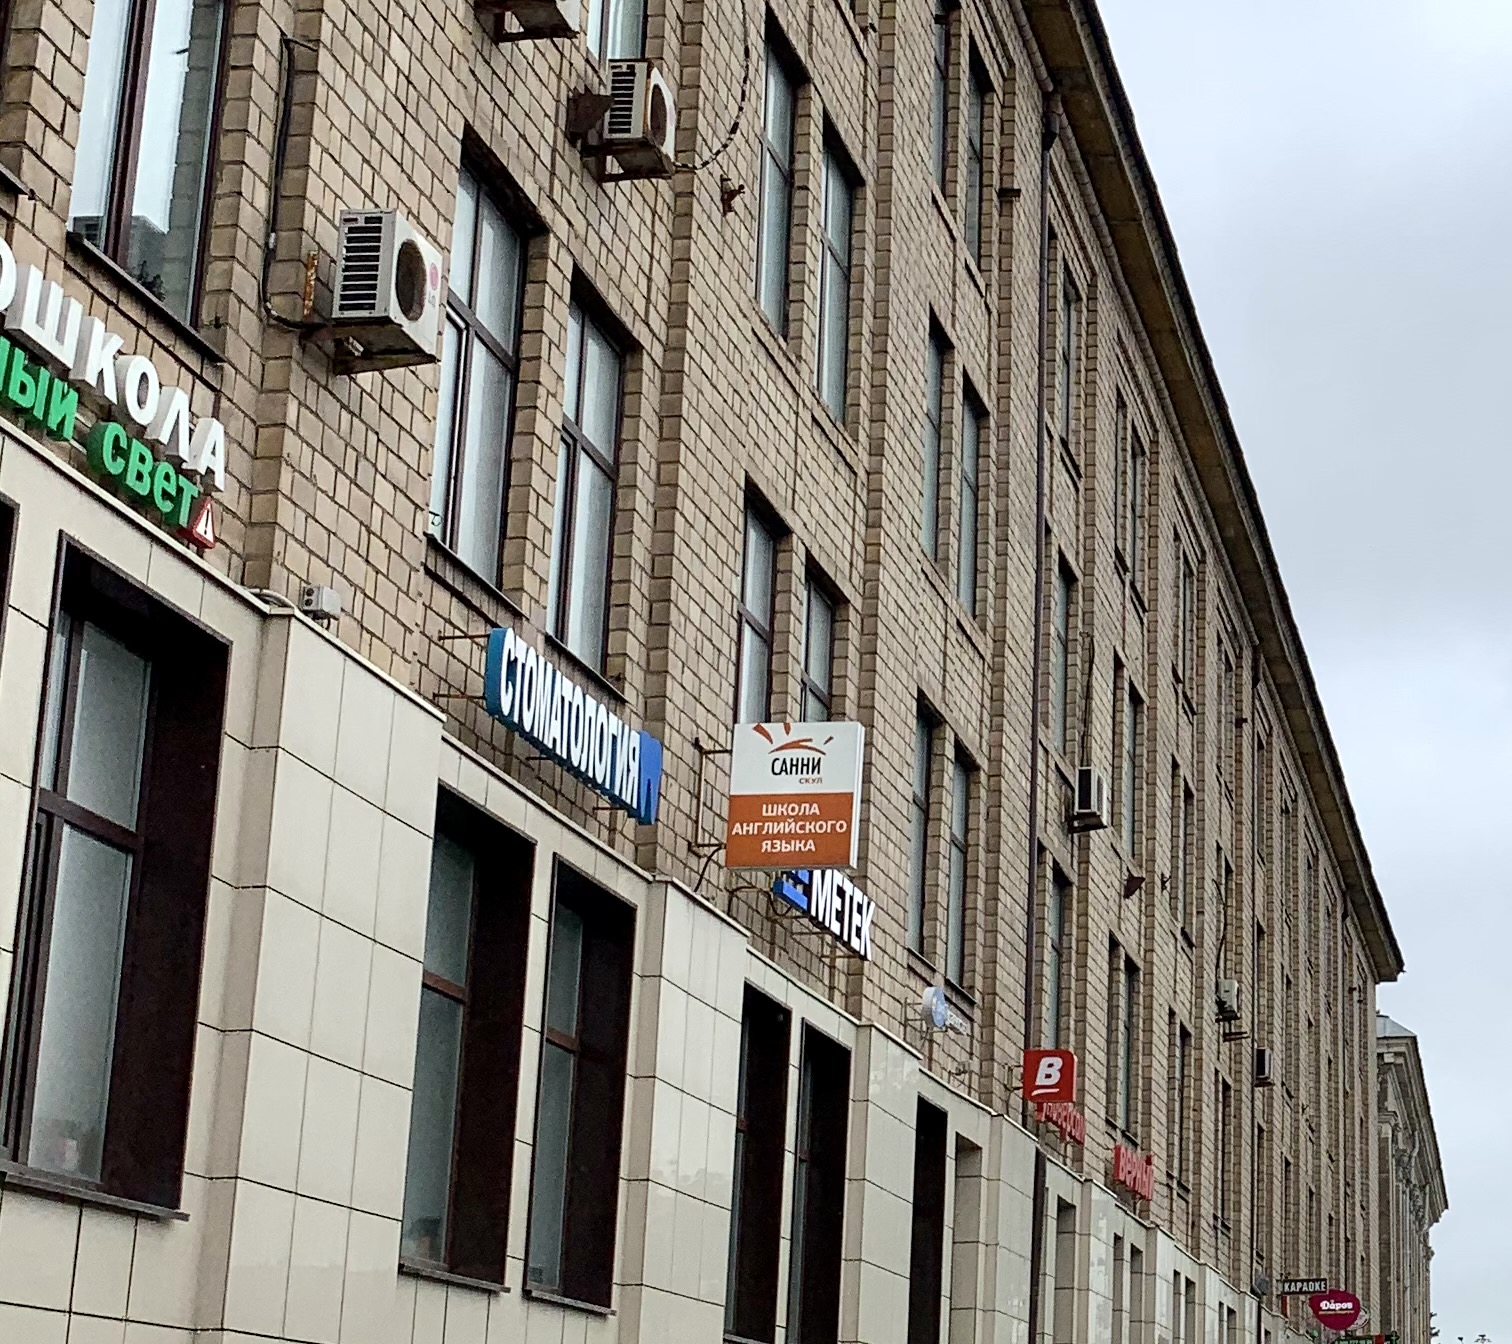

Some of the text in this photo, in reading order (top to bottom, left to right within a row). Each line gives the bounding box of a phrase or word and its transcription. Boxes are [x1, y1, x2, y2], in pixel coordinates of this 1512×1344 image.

[500, 628, 641, 810] СТОМАТОЛОГИЯ
[771, 757, 822, 776] САННИ
[761, 803, 820, 817] ШКОЛА
[731, 817, 848, 836] АНГЛИЙСКОГО
[761, 839, 816, 853] ЯЗЫКА
[811, 868, 875, 962] МЕТЕК
[1284, 1281, 1326, 1293] КАРАОКЕ
